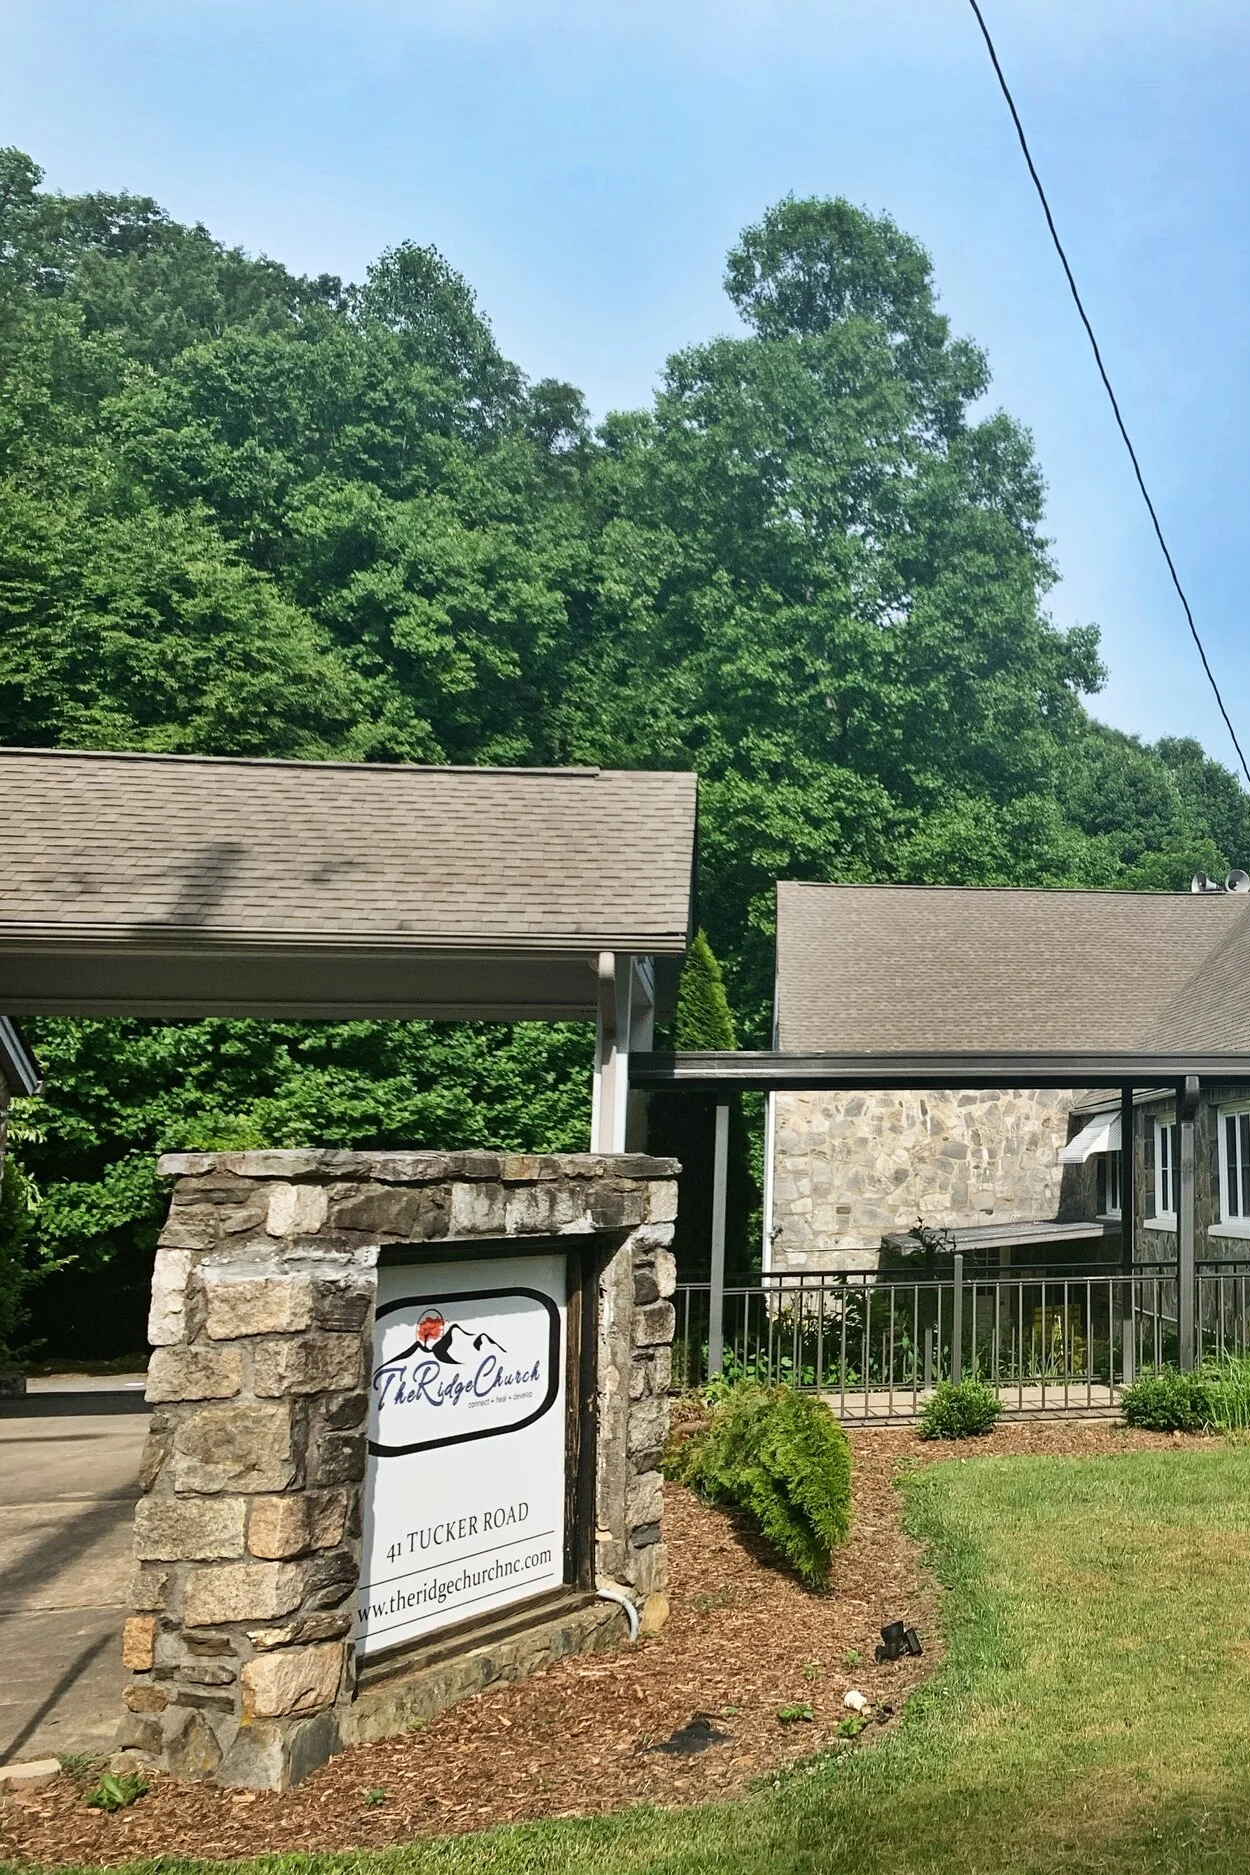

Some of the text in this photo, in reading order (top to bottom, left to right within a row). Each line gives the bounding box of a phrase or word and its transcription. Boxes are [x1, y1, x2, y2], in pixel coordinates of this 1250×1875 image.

[468, 1398, 490, 1409] connect
[512, 1391, 533, 1401] develop
[386, 1502, 530, 1564] 41 TUCKER ROAD
[357, 1549, 552, 1623] ww.theridgechurchnc.com
